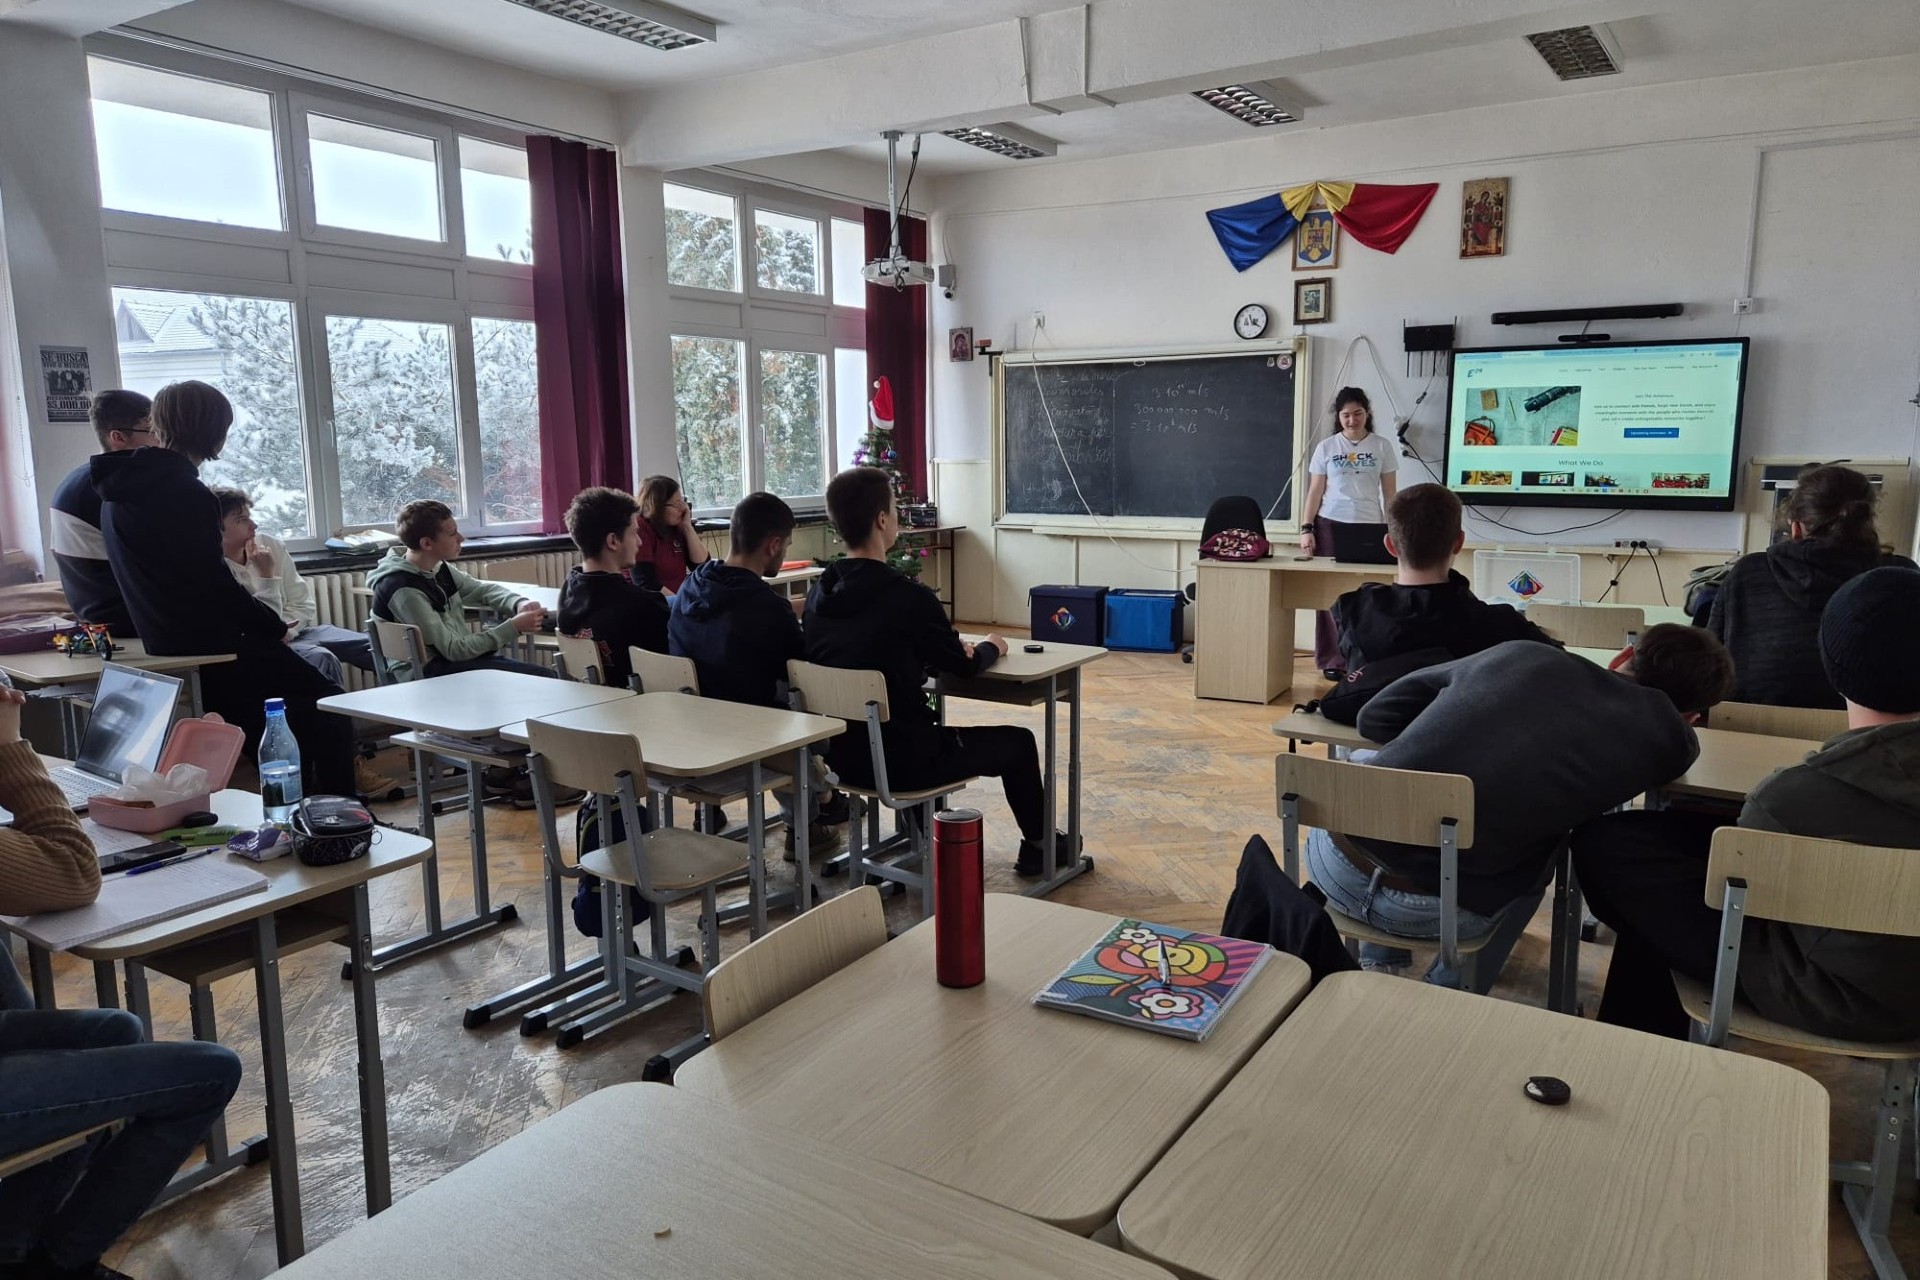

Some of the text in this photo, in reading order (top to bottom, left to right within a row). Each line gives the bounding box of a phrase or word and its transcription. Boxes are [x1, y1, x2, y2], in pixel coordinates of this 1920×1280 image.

[41, 351, 88, 363] SE BUSCA
[1333, 459, 1377, 469] WAVES
